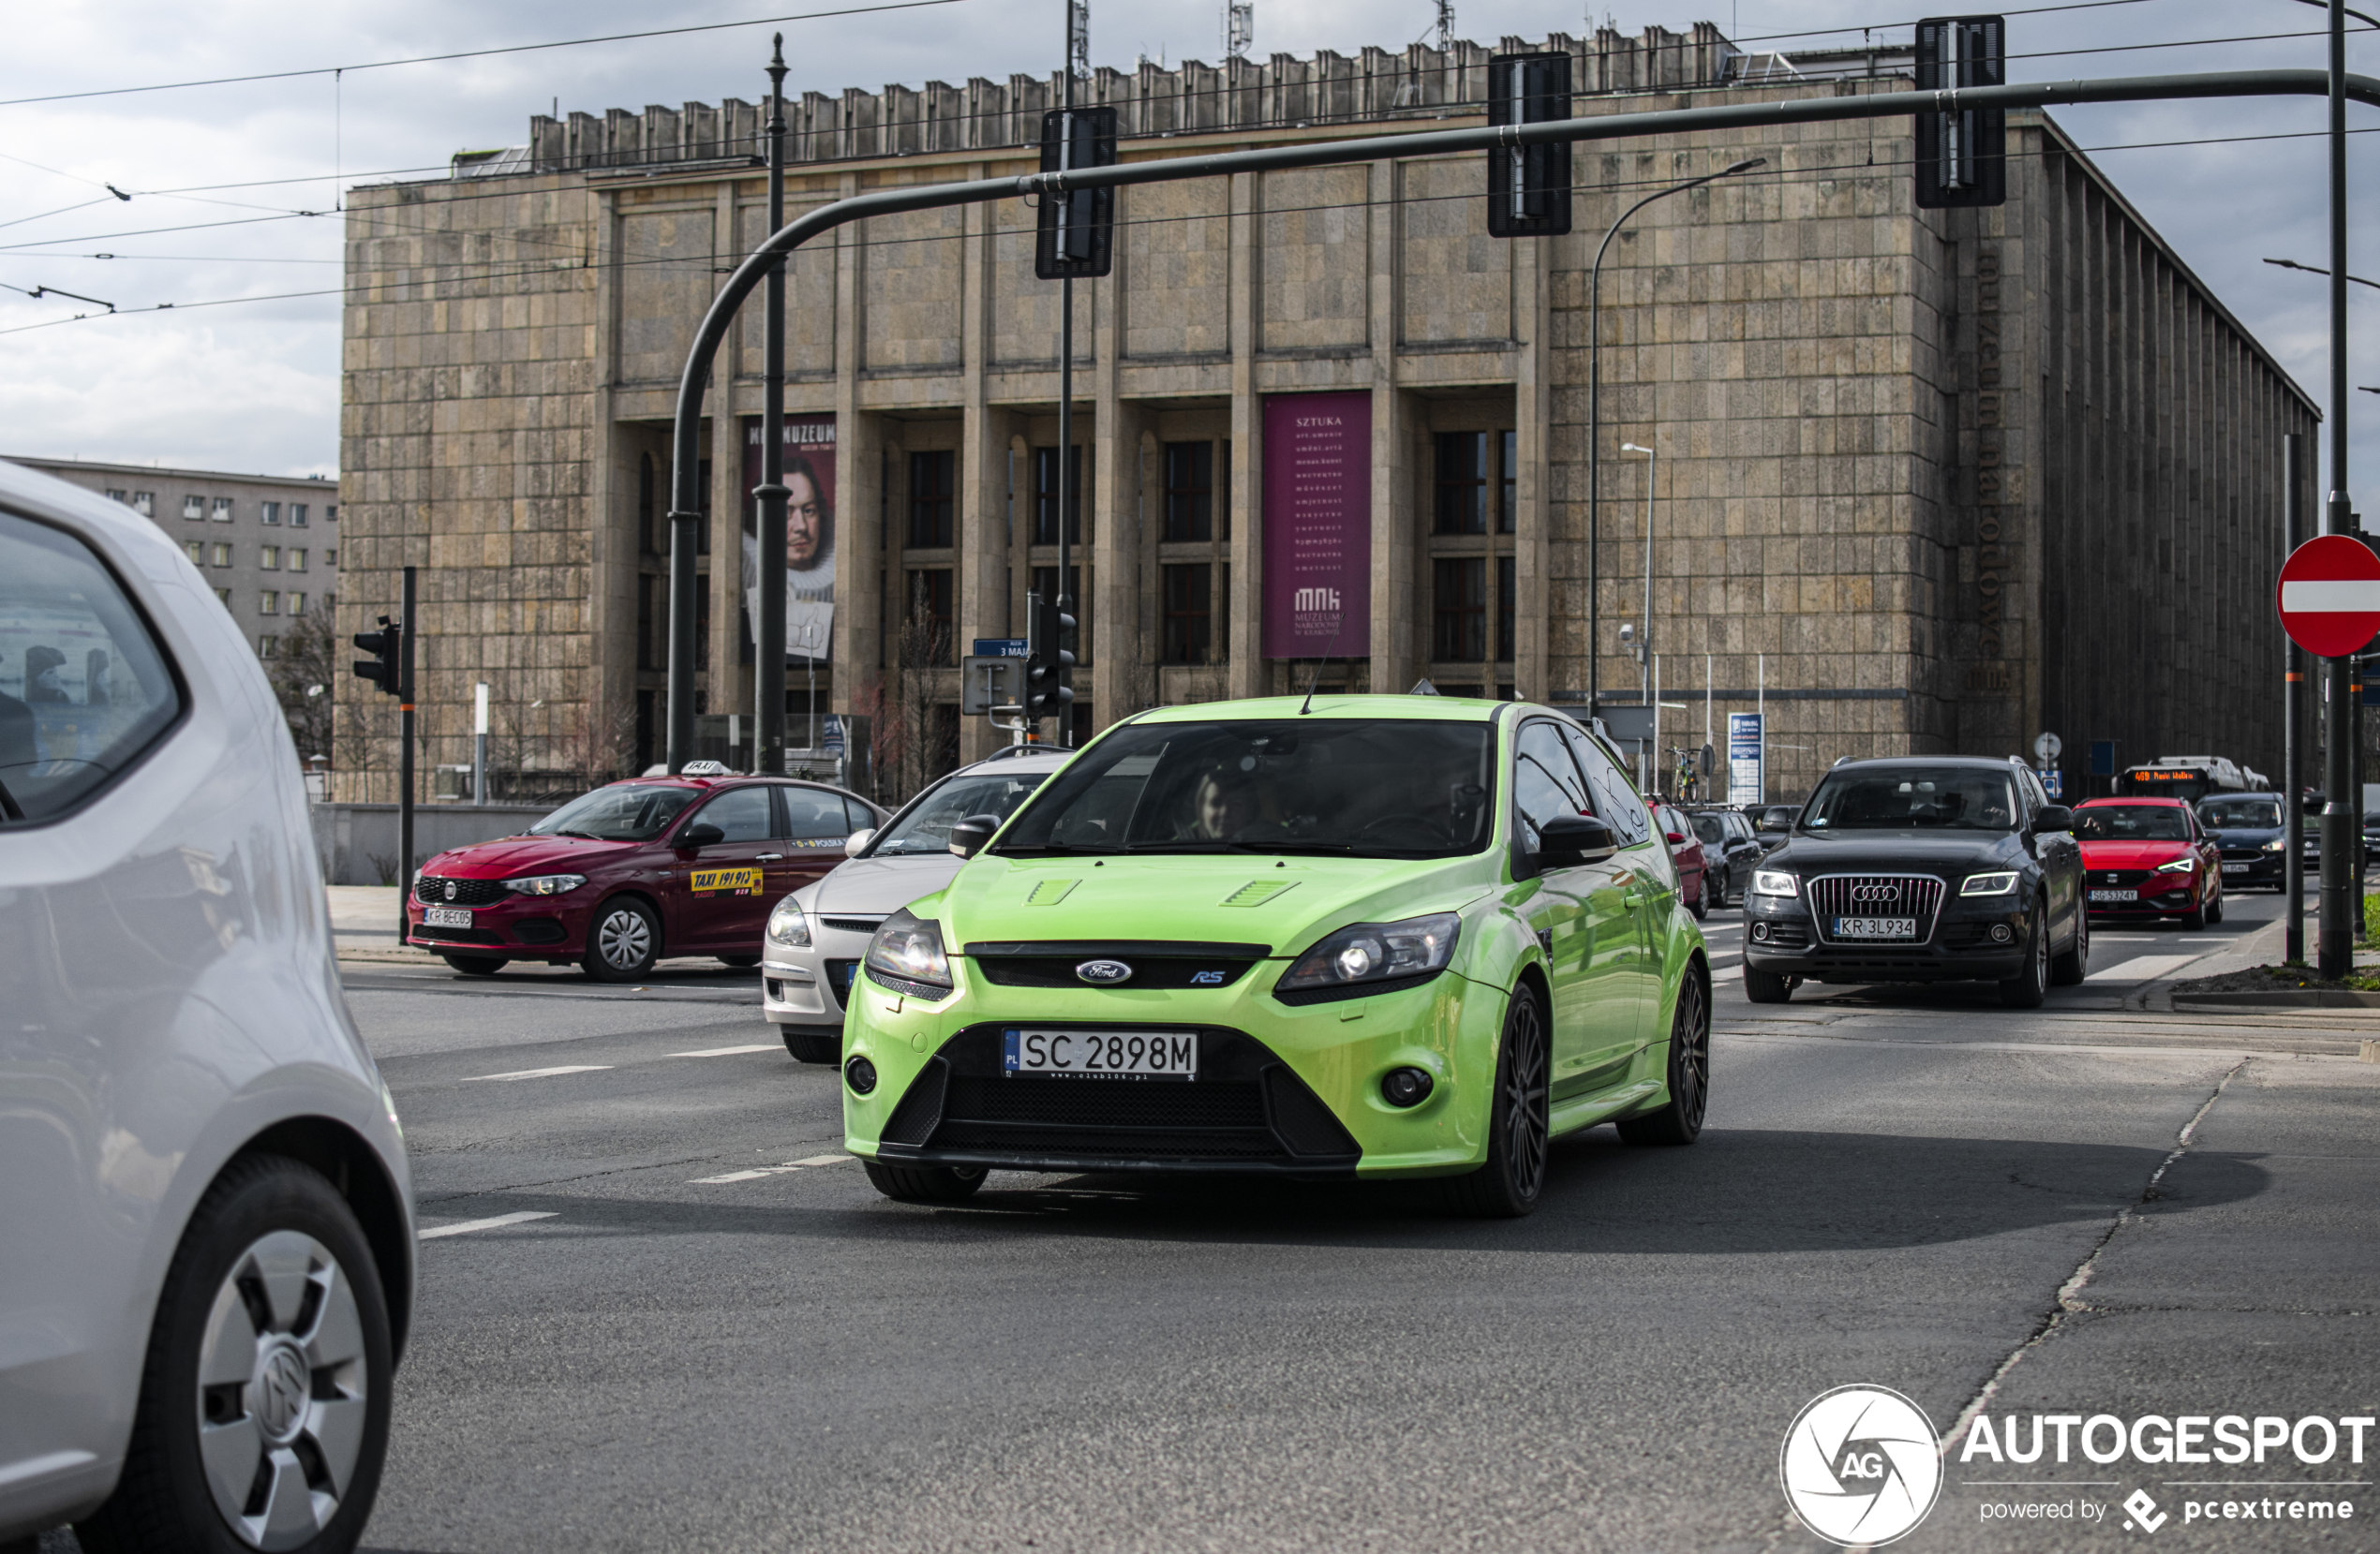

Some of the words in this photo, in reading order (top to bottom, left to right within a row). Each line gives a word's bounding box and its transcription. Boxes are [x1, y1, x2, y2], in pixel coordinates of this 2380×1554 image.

[1296, 418, 1342, 427] SZTUKA
[783, 423, 836, 444] MUZEUM
[1978, 443, 2010, 655] narodowe
[1295, 613, 1340, 622] MUZEUM
[1001, 647, 1006, 657] 3
[688, 762, 715, 770] TAXI
[814, 839, 845, 848] POLSKA
[694, 872, 717, 888] TAXI
[718, 872, 736, 886] 191
[2093, 891, 2105, 900] SG
[2108, 891, 2135, 900] 5324Y
[429, 910, 441, 923] KR
[1842, 919, 1863, 934] KR
[1868, 919, 1912, 934] 3L934
[1088, 964, 1119, 979] Ford
[1189, 970, 1226, 984] RS
[1006, 1054, 1019, 1064] PL
[1026, 1034, 1072, 1068] SC
[1085, 1036, 1191, 1071] 2898M
